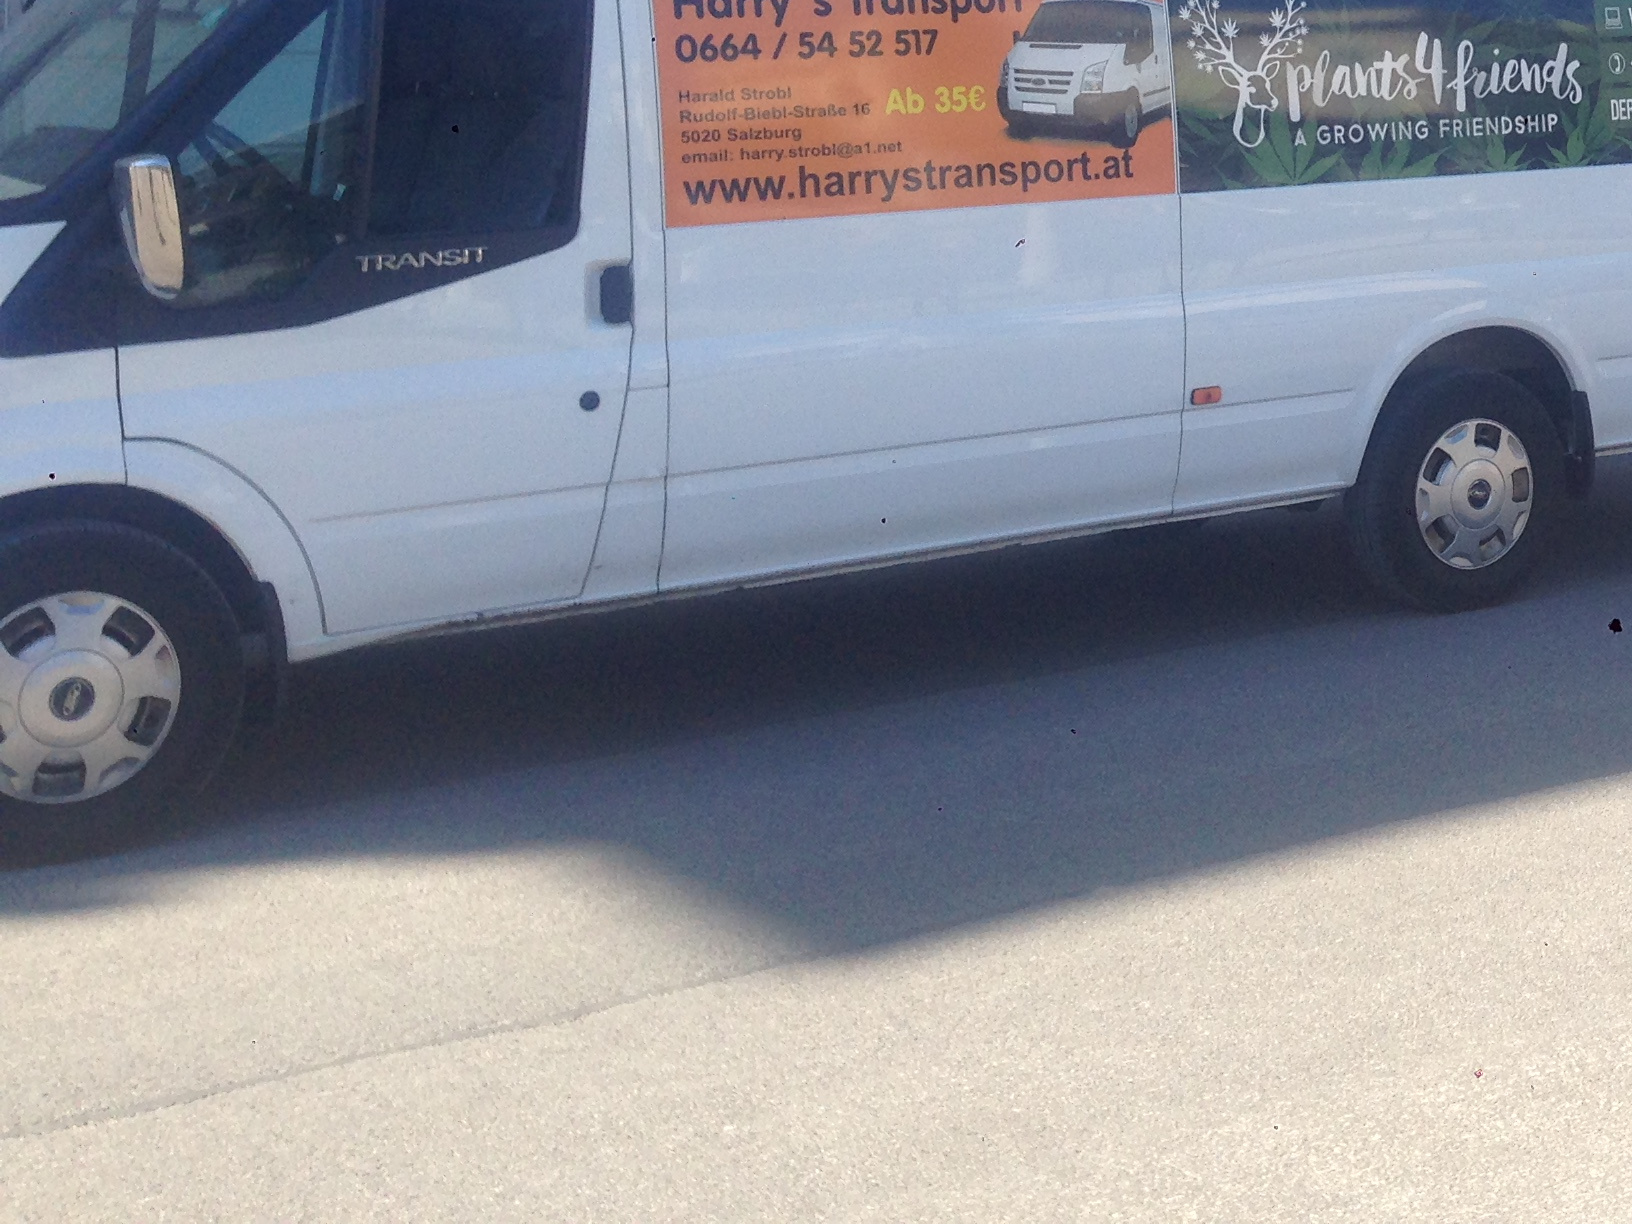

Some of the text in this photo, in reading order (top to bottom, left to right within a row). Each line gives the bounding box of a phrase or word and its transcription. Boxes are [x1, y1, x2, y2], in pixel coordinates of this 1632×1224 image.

[675, 33, 762, 63] 0664
[798, 31, 837, 59] 54
[849, 30, 884, 57] 52
[895, 29, 938, 56] 517
[678, 87, 792, 103] Harald Strobl
[885, 85, 986, 116] Ab 35€
[679, 103, 870, 123] Rudolf-Biebl-Straße 16
[681, 127, 802, 143] 5020 Salzburg
[1294, 113, 1558, 146] A GROWING FRIENDSHIP
[682, 149, 733, 164] email:
[683, 149, 1134, 206] www.harrystransport.at
[355, 246, 488, 272] TRANSIT
